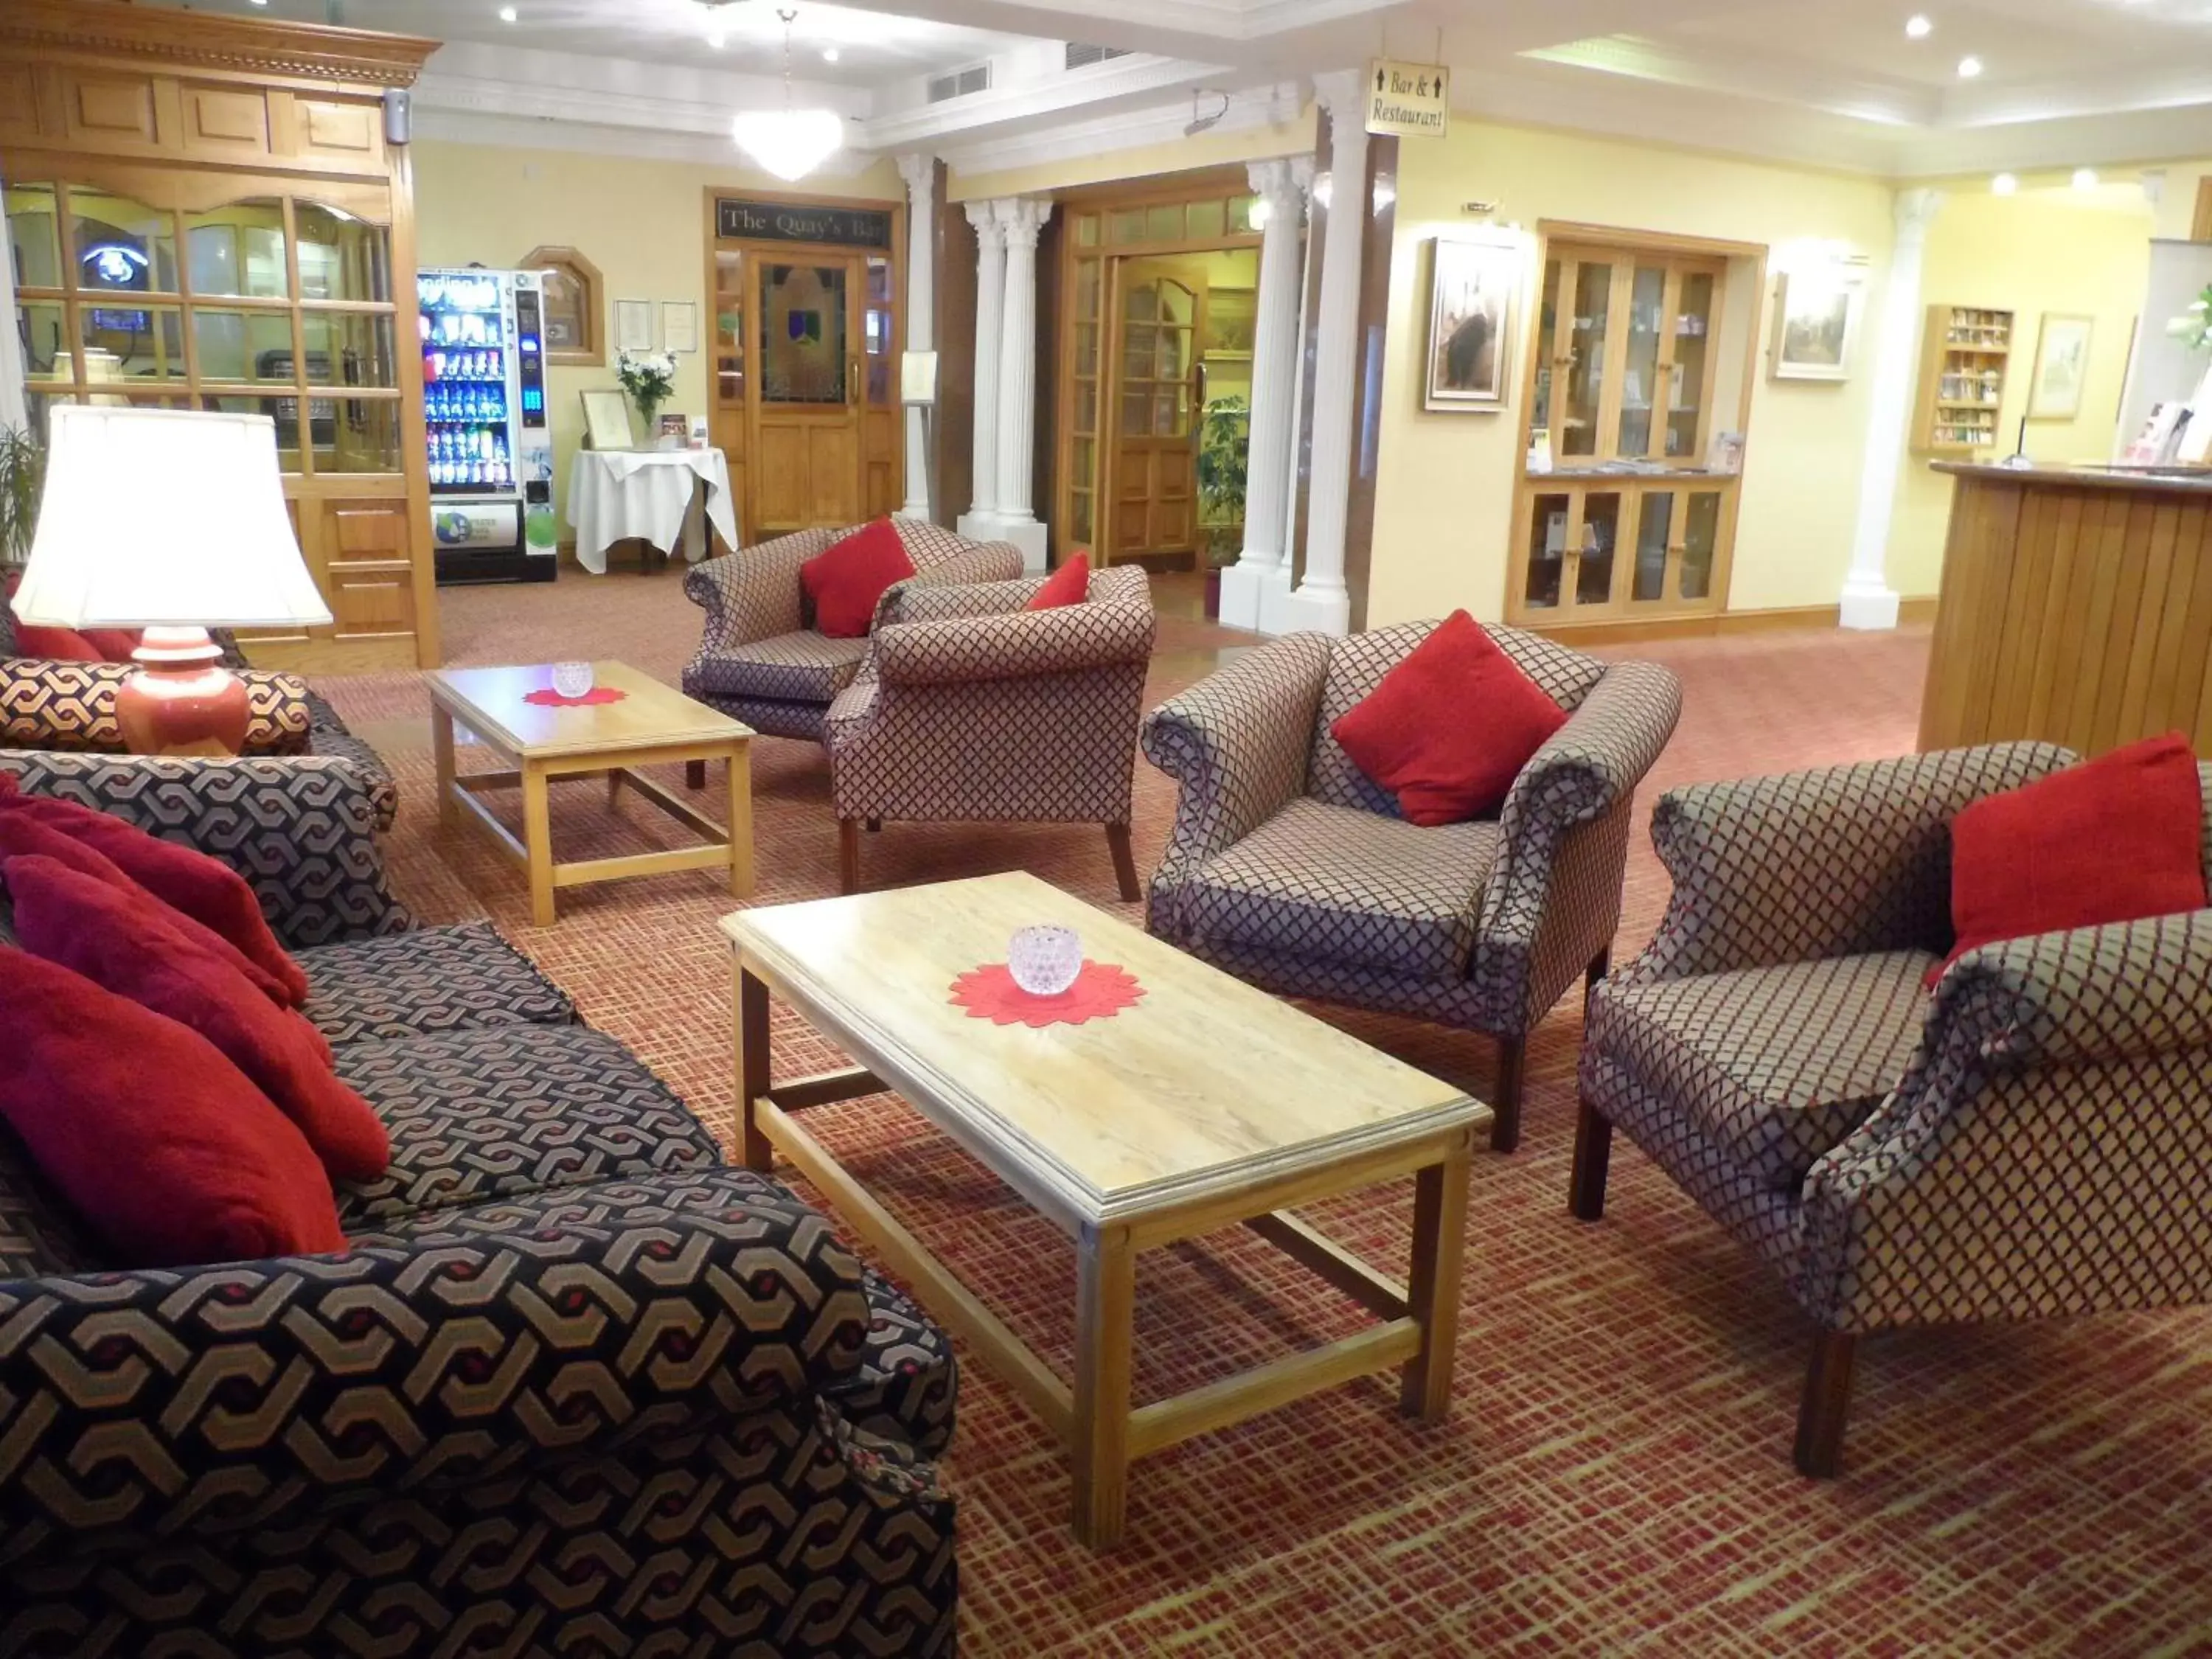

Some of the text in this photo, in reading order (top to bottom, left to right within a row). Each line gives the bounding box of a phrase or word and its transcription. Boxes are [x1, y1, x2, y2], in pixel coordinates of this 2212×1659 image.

[1391, 72, 1428, 97] Bar &
[1373, 97, 1442, 127] Restaurant
[725, 209, 883, 240] The Quay's Bar
